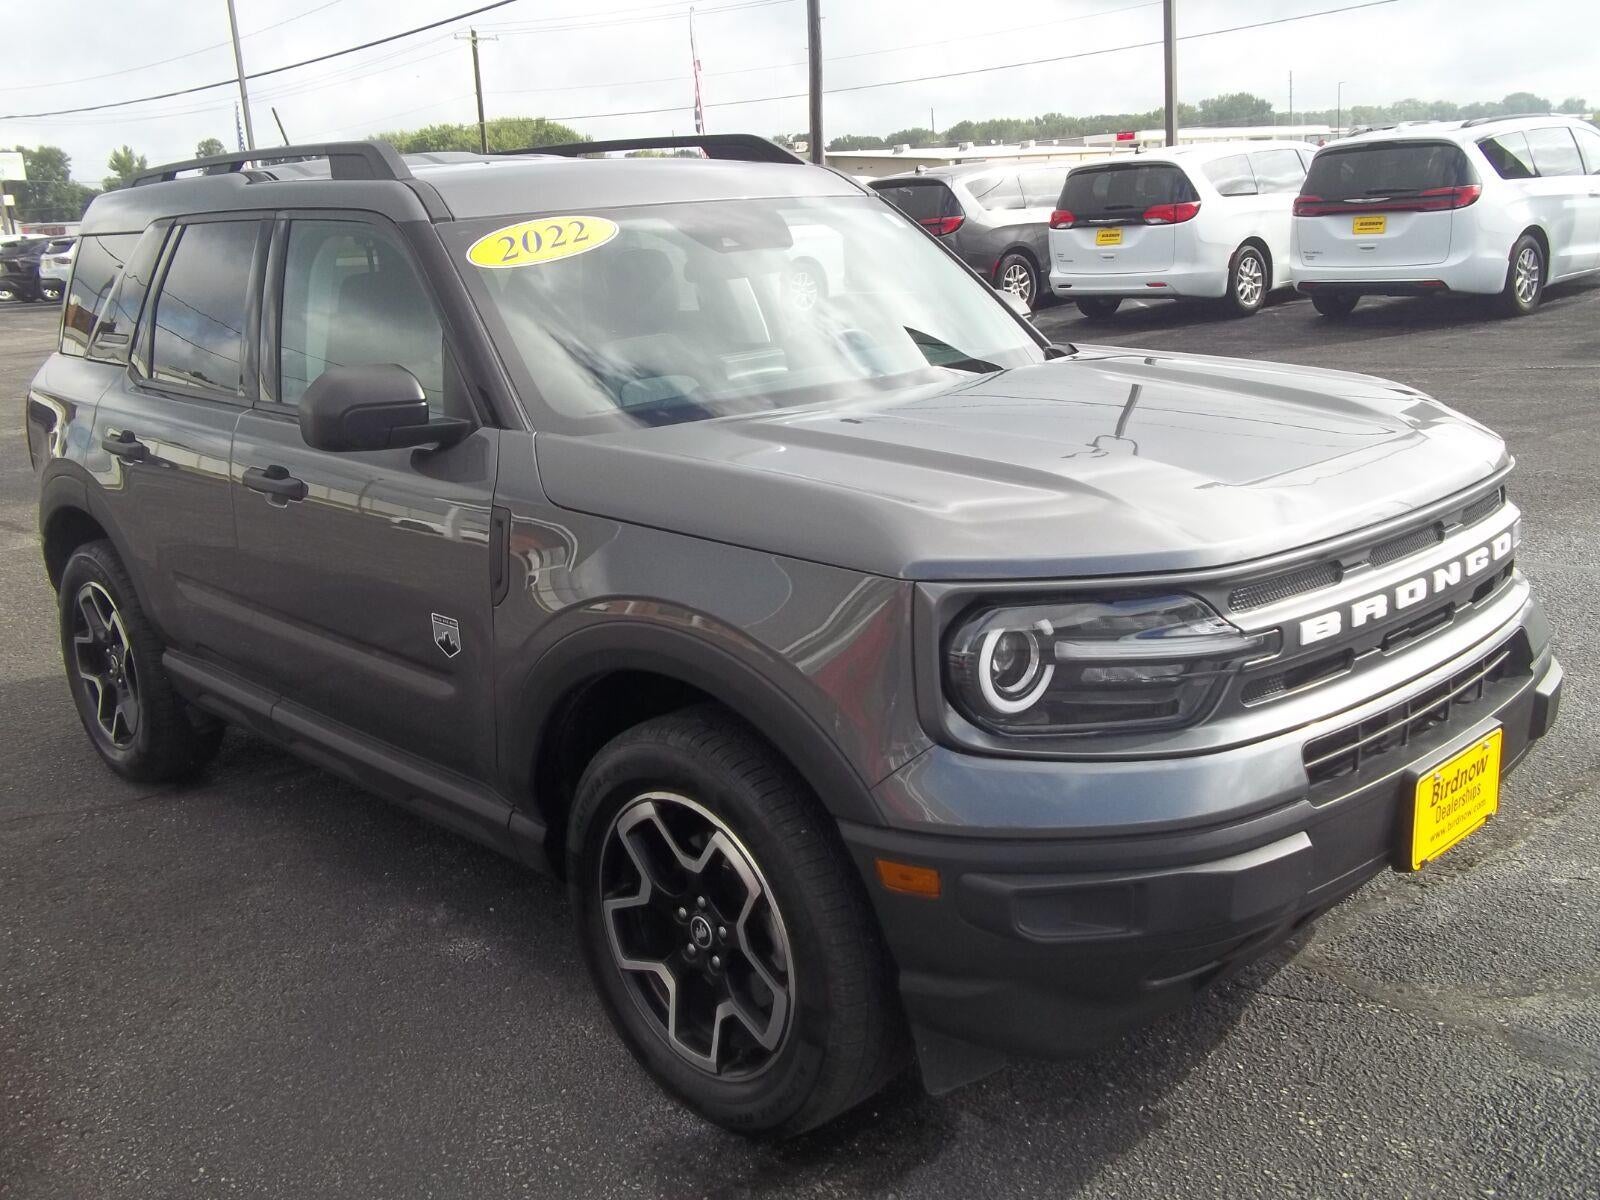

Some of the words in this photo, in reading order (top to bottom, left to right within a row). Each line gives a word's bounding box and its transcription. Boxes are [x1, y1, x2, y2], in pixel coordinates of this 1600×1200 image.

[497, 220, 589, 262] 2022
[1299, 532, 1512, 646] BRONCO
[1429, 754, 1489, 808] Birdnow
[1435, 783, 1481, 824] Dealerships
